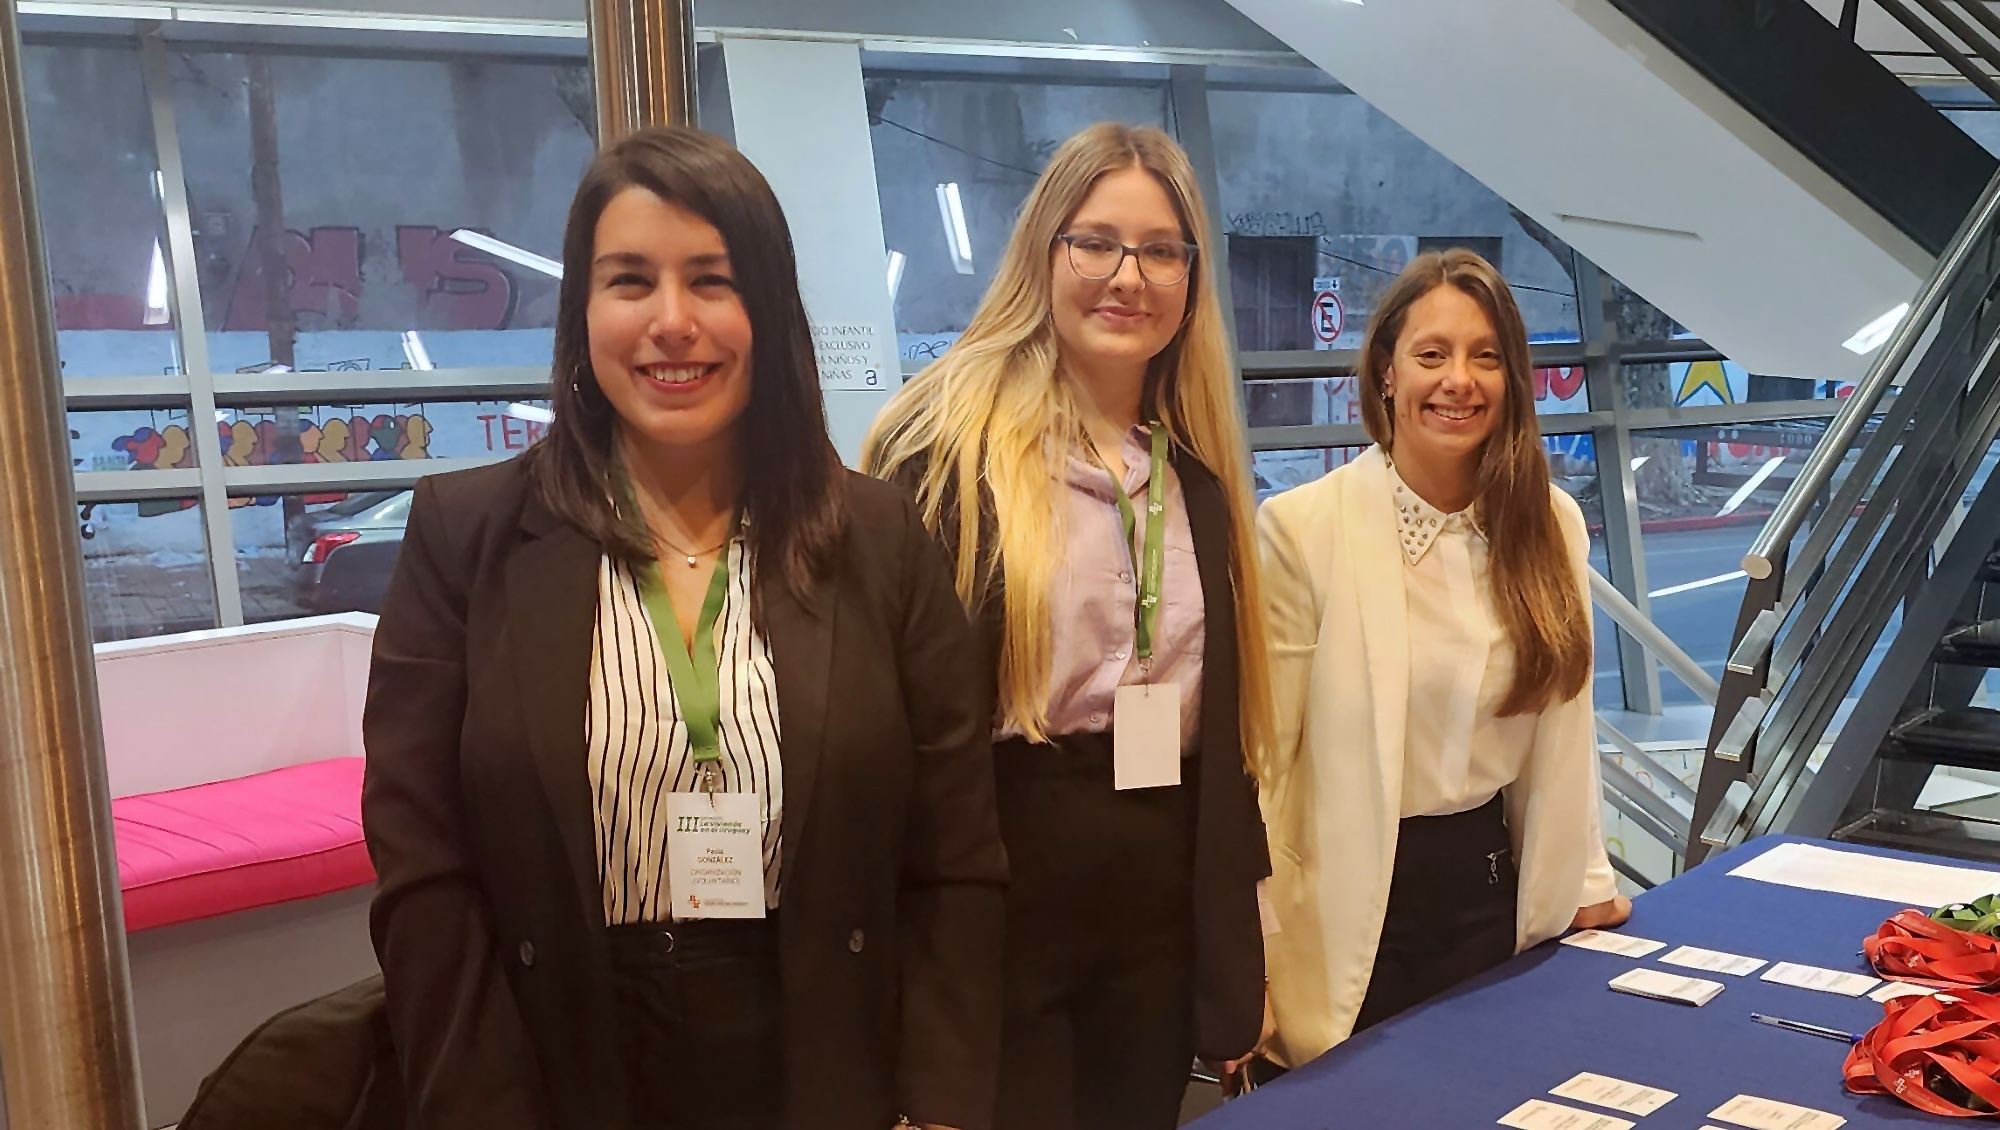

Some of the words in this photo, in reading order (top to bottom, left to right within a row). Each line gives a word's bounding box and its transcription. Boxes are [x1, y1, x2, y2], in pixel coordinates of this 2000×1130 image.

[832, 326, 875, 336] INFANTIL
[819, 341, 871, 351] EXCLUSIVO
[828, 353, 861, 365] NIÑOS
[862, 355, 869, 365] Y
[821, 367, 853, 380] NIÑAS
[865, 369, 878, 386] a
